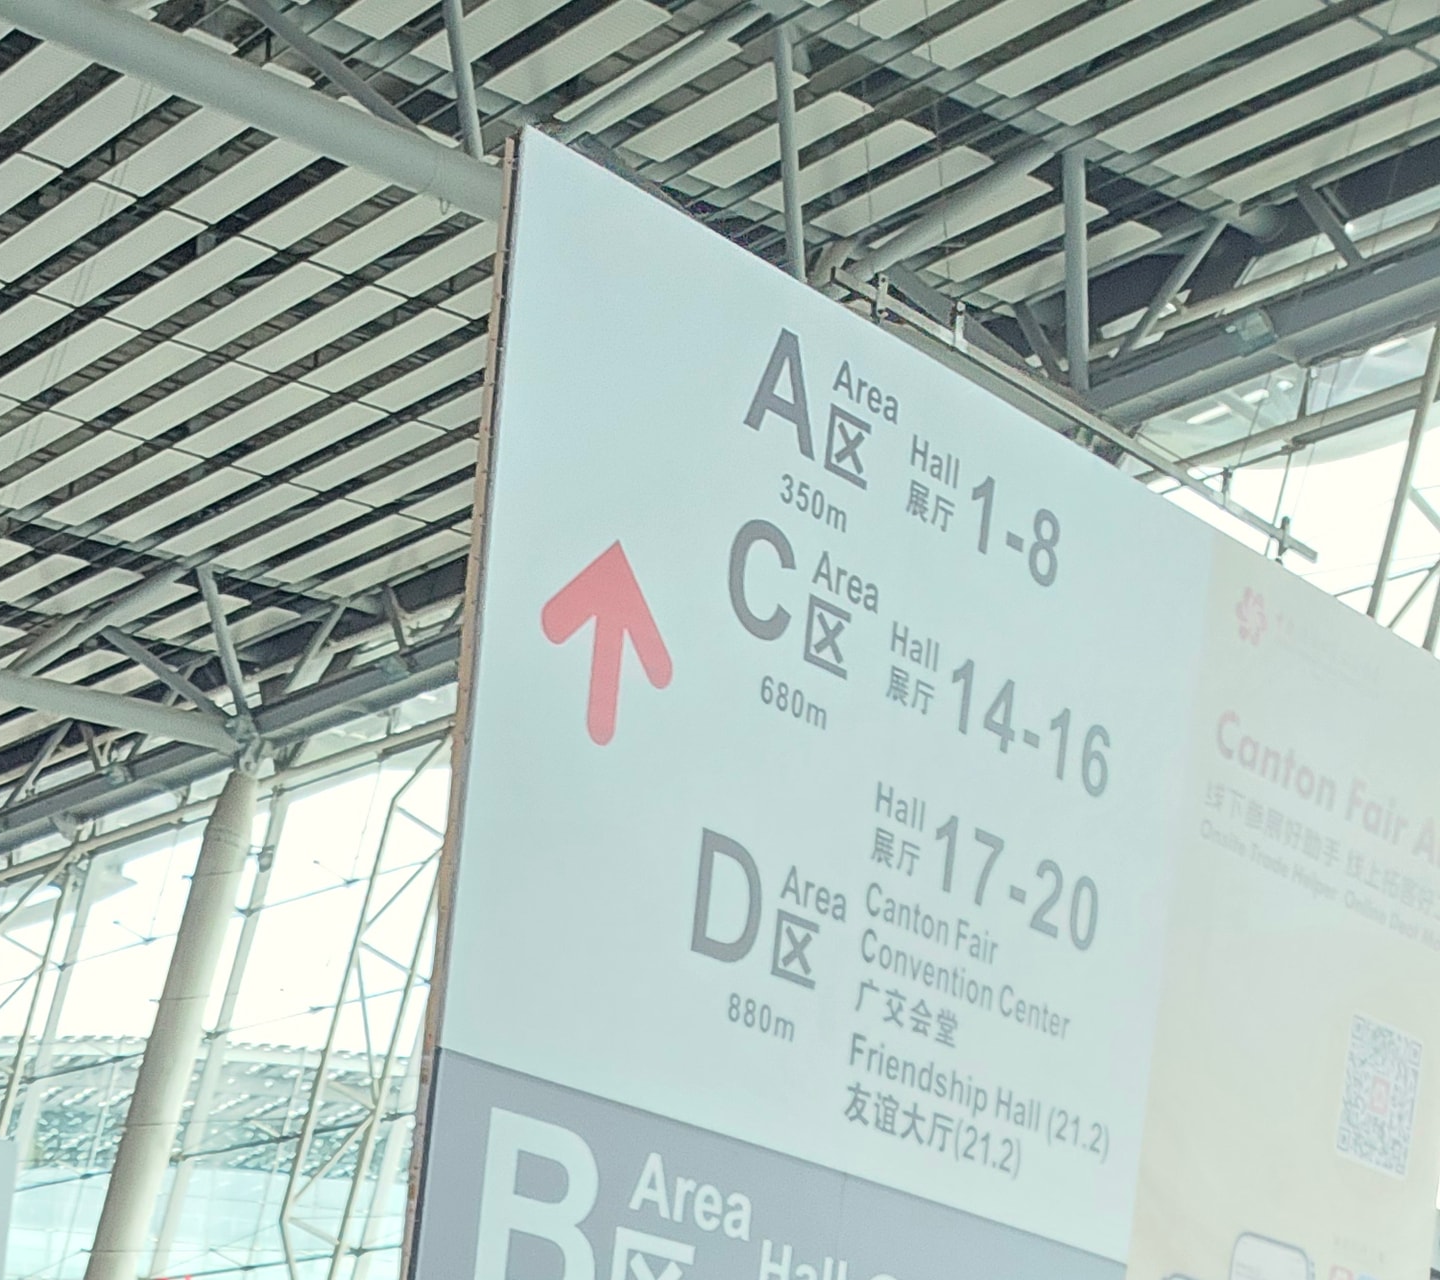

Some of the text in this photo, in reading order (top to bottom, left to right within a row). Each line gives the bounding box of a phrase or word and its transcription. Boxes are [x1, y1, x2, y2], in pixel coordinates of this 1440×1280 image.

[743, 327, 815, 462] A
[832, 360, 900, 426] Area
[824, 403, 872, 491] 区
[779, 473, 848, 533] 350m
[906, 479, 956, 533] 展厅
[910, 434, 1061, 588] Hall 1-8
[727, 518, 797, 642] C
[811, 550, 880, 615] Area
[803, 593, 852, 681] 区
[759, 675, 829, 731] 680m
[885, 664, 936, 717] 展厅
[890, 620, 1111, 798] Hall 14-16
[1216, 709, 1336, 812] Canton
[1345, 777, 1409, 846] Fair
[779, 864, 848, 923] Area
[871, 826, 921, 878] 展厅
[875, 780, 1099, 952] Hall 17-20
[690, 827, 762, 964] D
[865, 882, 999, 965] Canton Fair
[771, 909, 821, 990] 区
[861, 928, 1071, 1040] Convention Center
[726, 992, 796, 1044] 880m
[854, 978, 959, 1049] 广交会堂
[849, 1032, 1110, 1165] Friendship Hall (21.2)
[628, 1152, 753, 1242] Area
